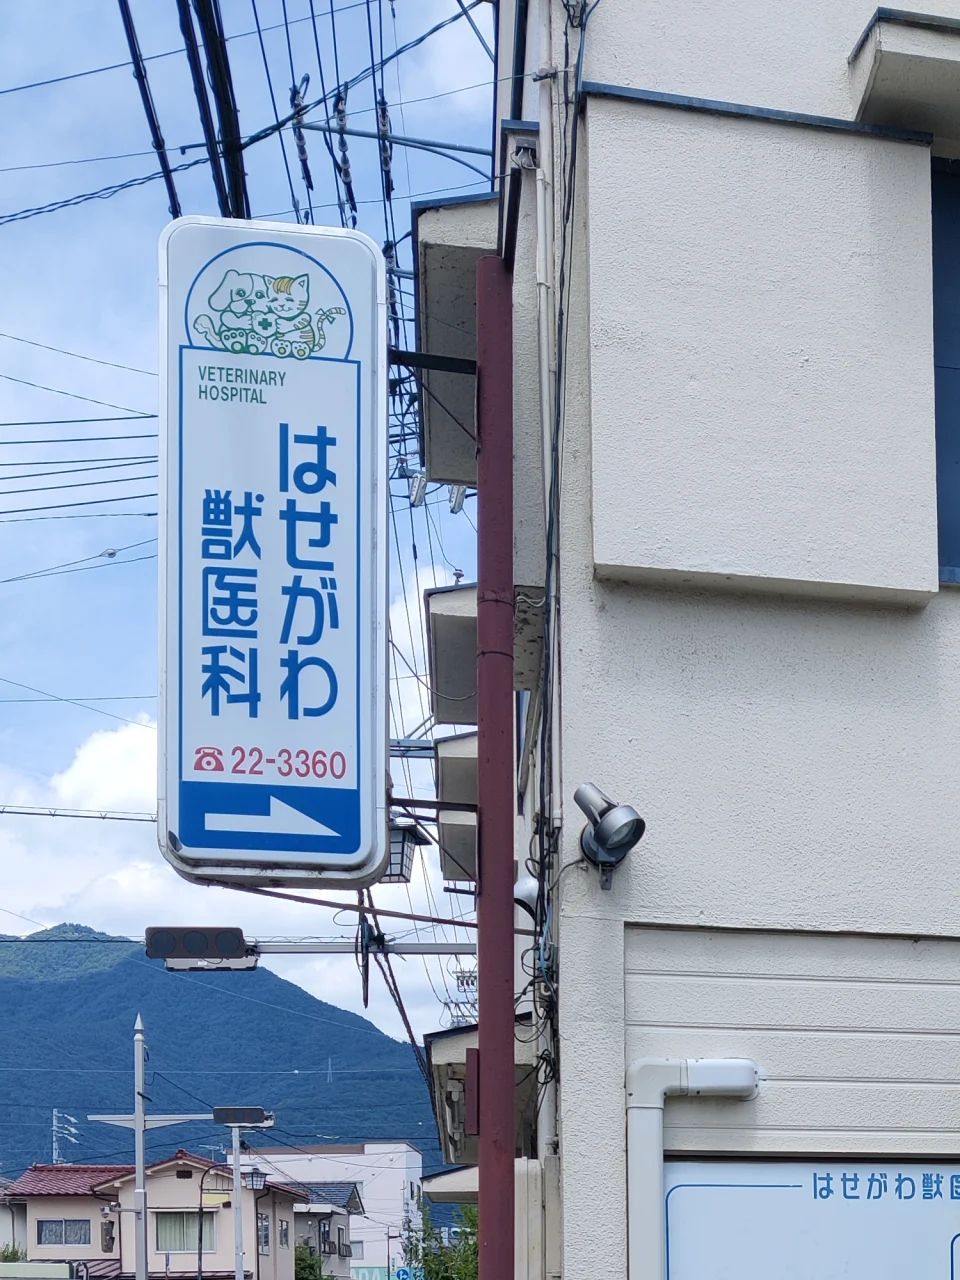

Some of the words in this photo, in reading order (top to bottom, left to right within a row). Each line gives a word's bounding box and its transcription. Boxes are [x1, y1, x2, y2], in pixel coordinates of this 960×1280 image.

[198, 365, 286, 387] VETERINARY
[198, 384, 268, 405] HOSPITAL
[279, 422, 339, 720] はせがわ
[201, 488, 264, 719] 獣医科
[231, 745, 347, 780] 22-3360
